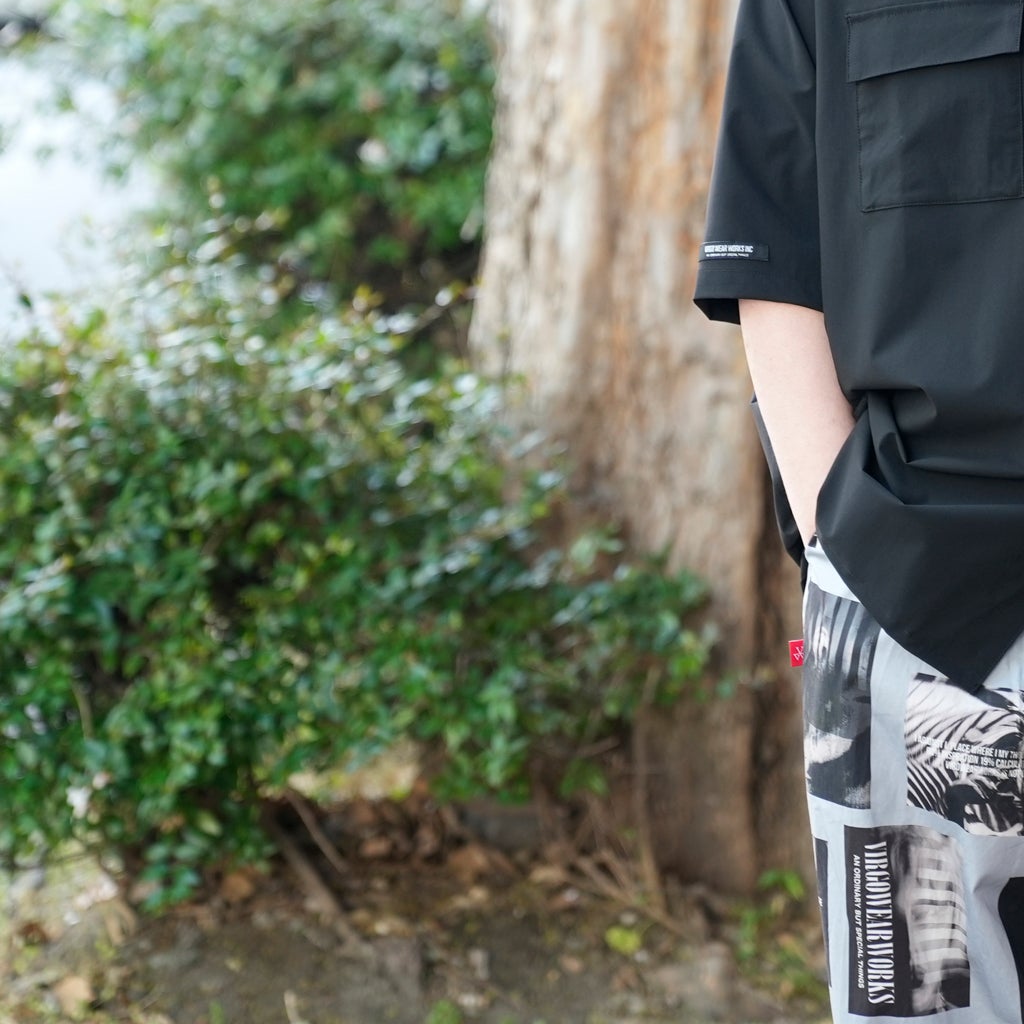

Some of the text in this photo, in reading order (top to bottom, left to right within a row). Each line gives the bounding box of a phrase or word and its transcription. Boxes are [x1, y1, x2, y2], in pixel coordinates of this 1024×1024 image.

[970, 743, 995, 757] WHERE
[998, 749, 1010, 758] MY
[853, 854, 865, 989] AN ORDINARY BUT SPECIAL THINGS
[864, 841, 895, 1004] VIRGOWEARWORKS
